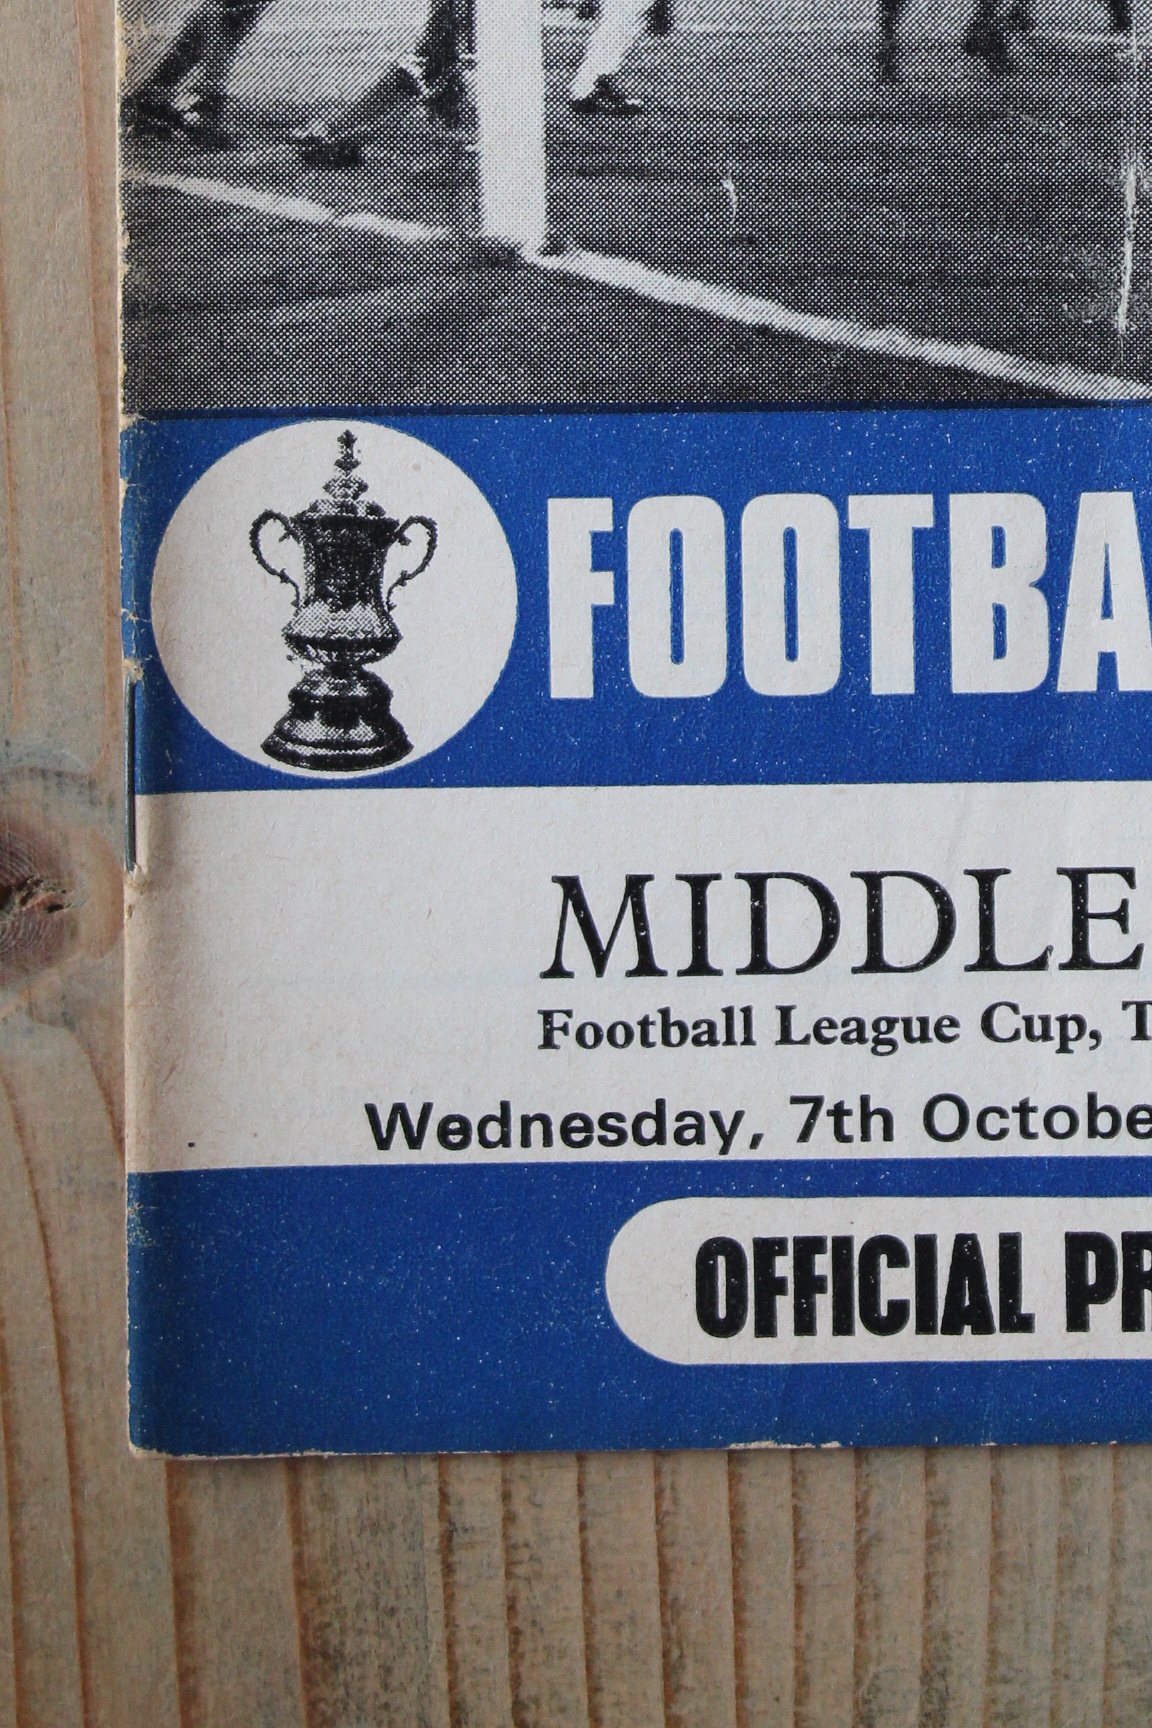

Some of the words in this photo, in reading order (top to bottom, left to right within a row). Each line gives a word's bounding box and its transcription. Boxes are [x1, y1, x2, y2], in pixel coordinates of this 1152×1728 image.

[537, 1004, 757, 1050] Football
[774, 1004, 961, 1057] League
[980, 1001, 1102, 1055] Cup,
[364, 1097, 764, 1156] Wednesday,
[788, 1092, 895, 1146] 7th
[694, 1231, 1037, 1340] OFFICIAL
